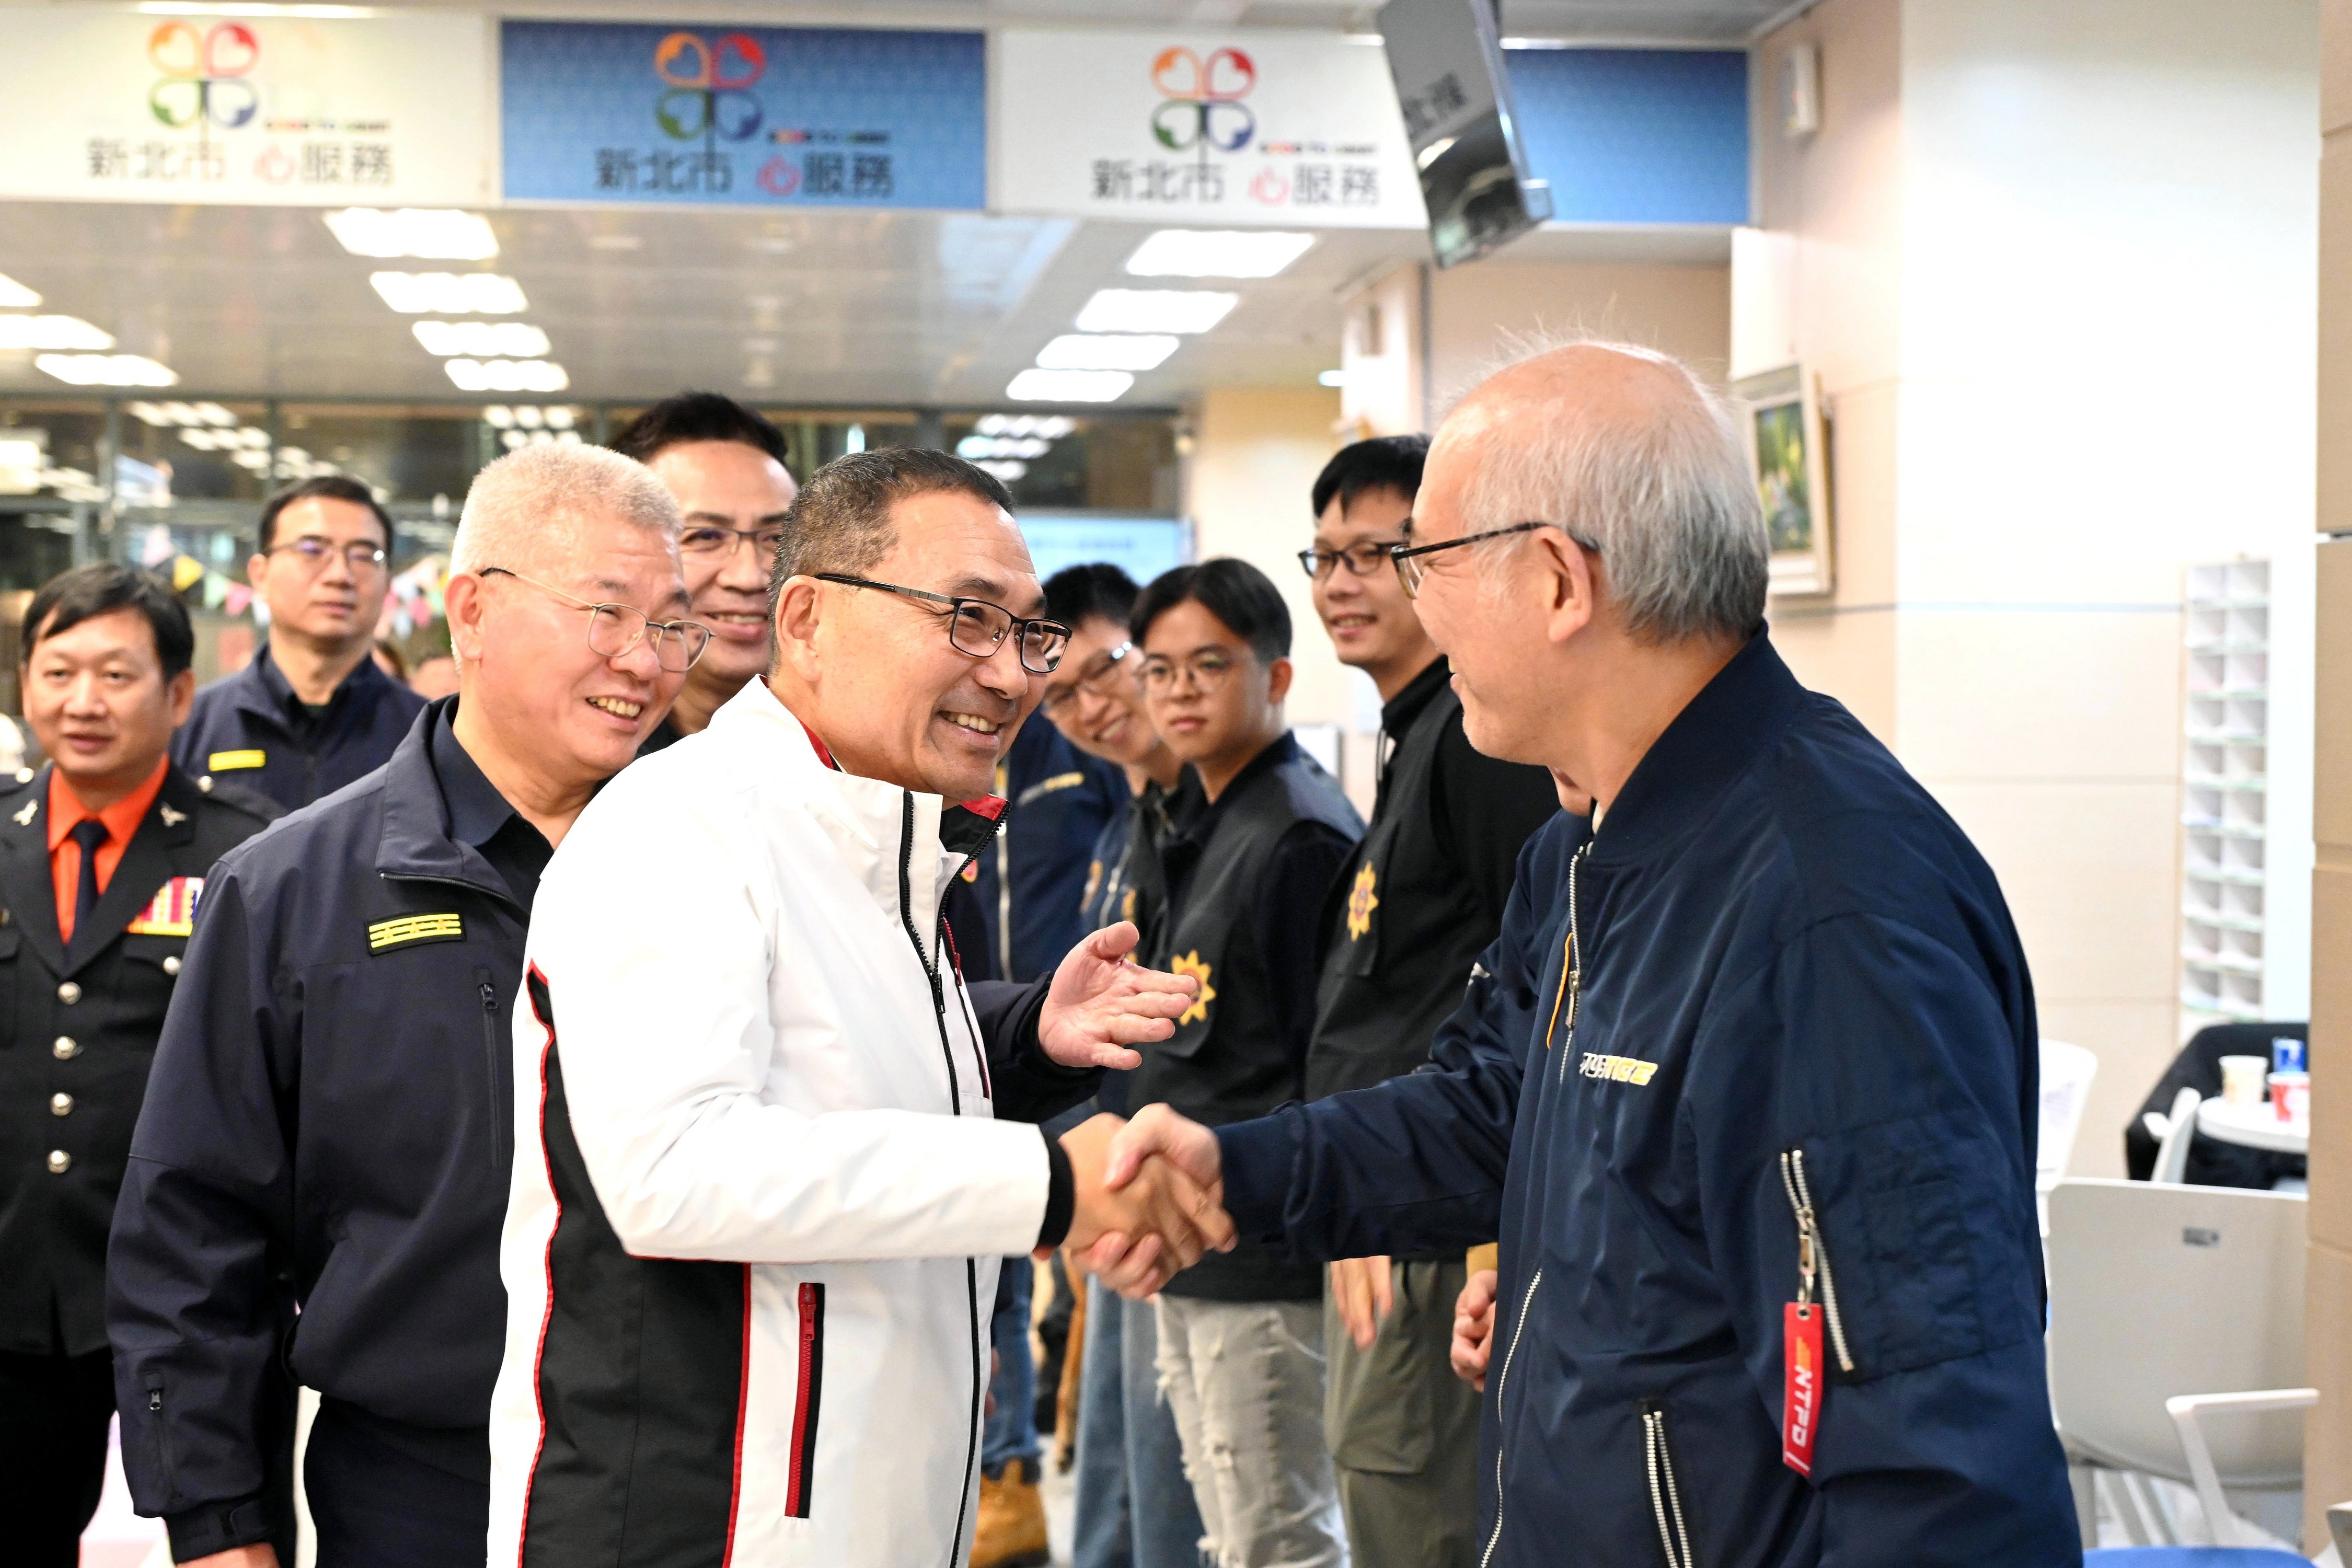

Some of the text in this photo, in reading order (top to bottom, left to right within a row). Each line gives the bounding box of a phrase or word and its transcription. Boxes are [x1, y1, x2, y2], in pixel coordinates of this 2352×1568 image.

[87, 137, 227, 181] 新北市
[595, 147, 733, 194] 新北市
[1092, 158, 1224, 202] 新北市
[1792, 1365, 1812, 1447] NTPD
